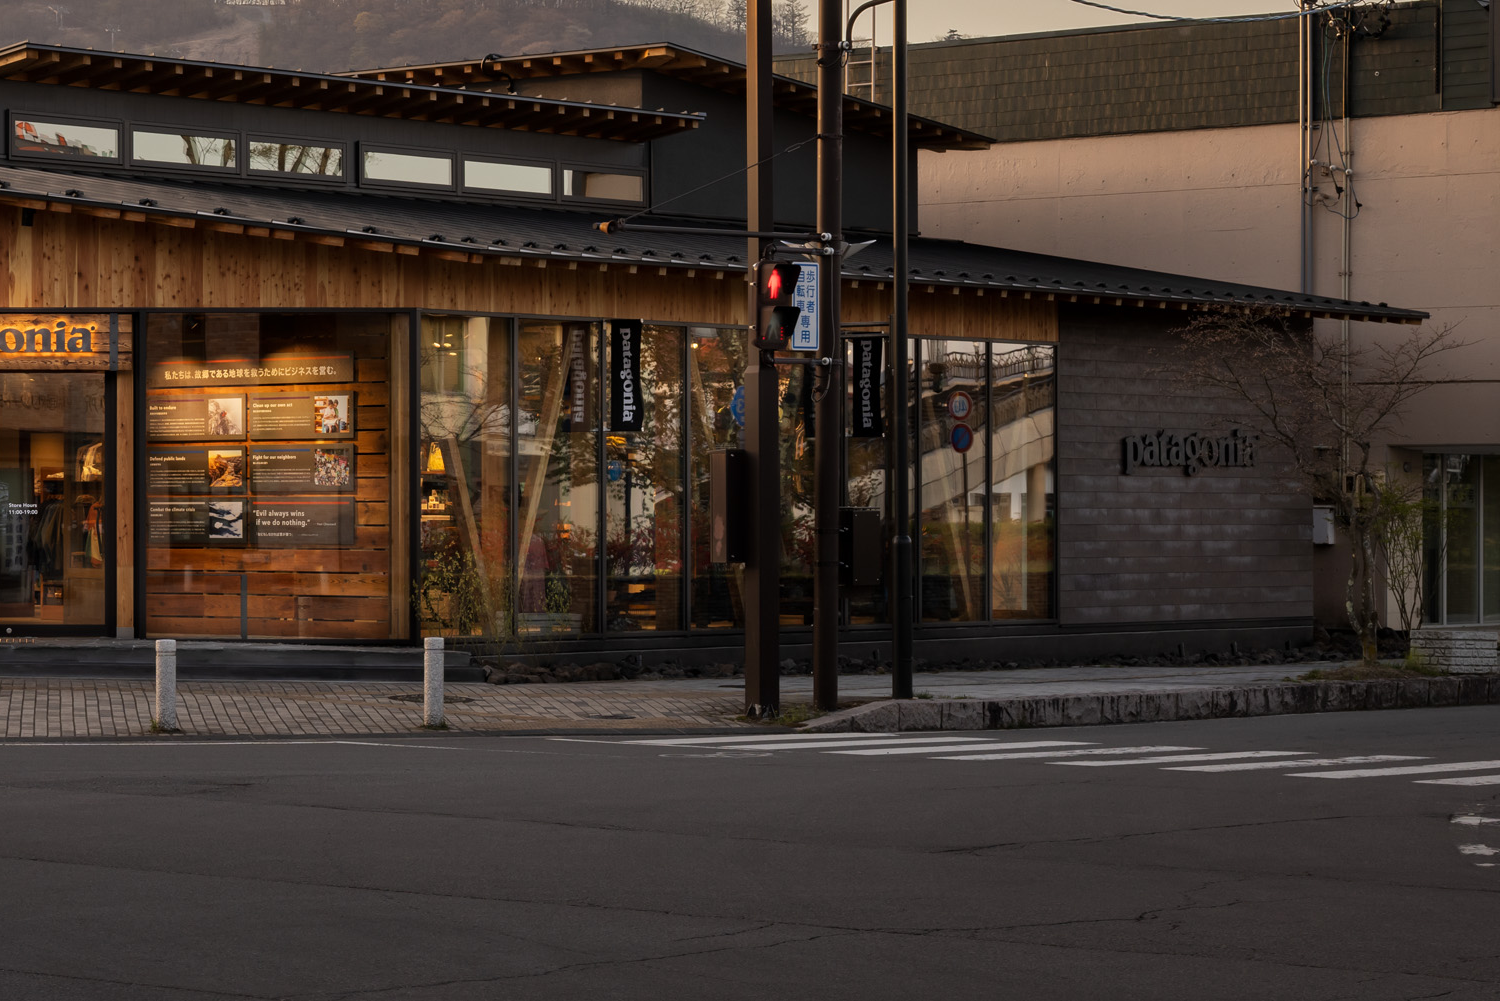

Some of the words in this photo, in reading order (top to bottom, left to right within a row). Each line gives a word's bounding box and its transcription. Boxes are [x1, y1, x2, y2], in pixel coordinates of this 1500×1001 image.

[806, 270, 816, 314] 歩行者
[800, 314, 811, 344] 専用
[620, 327, 636, 423] patagonia
[858, 339, 874, 429] patagonia
[1121, 429, 1259, 476] patagonia
[268, 510, 289, 518] always
